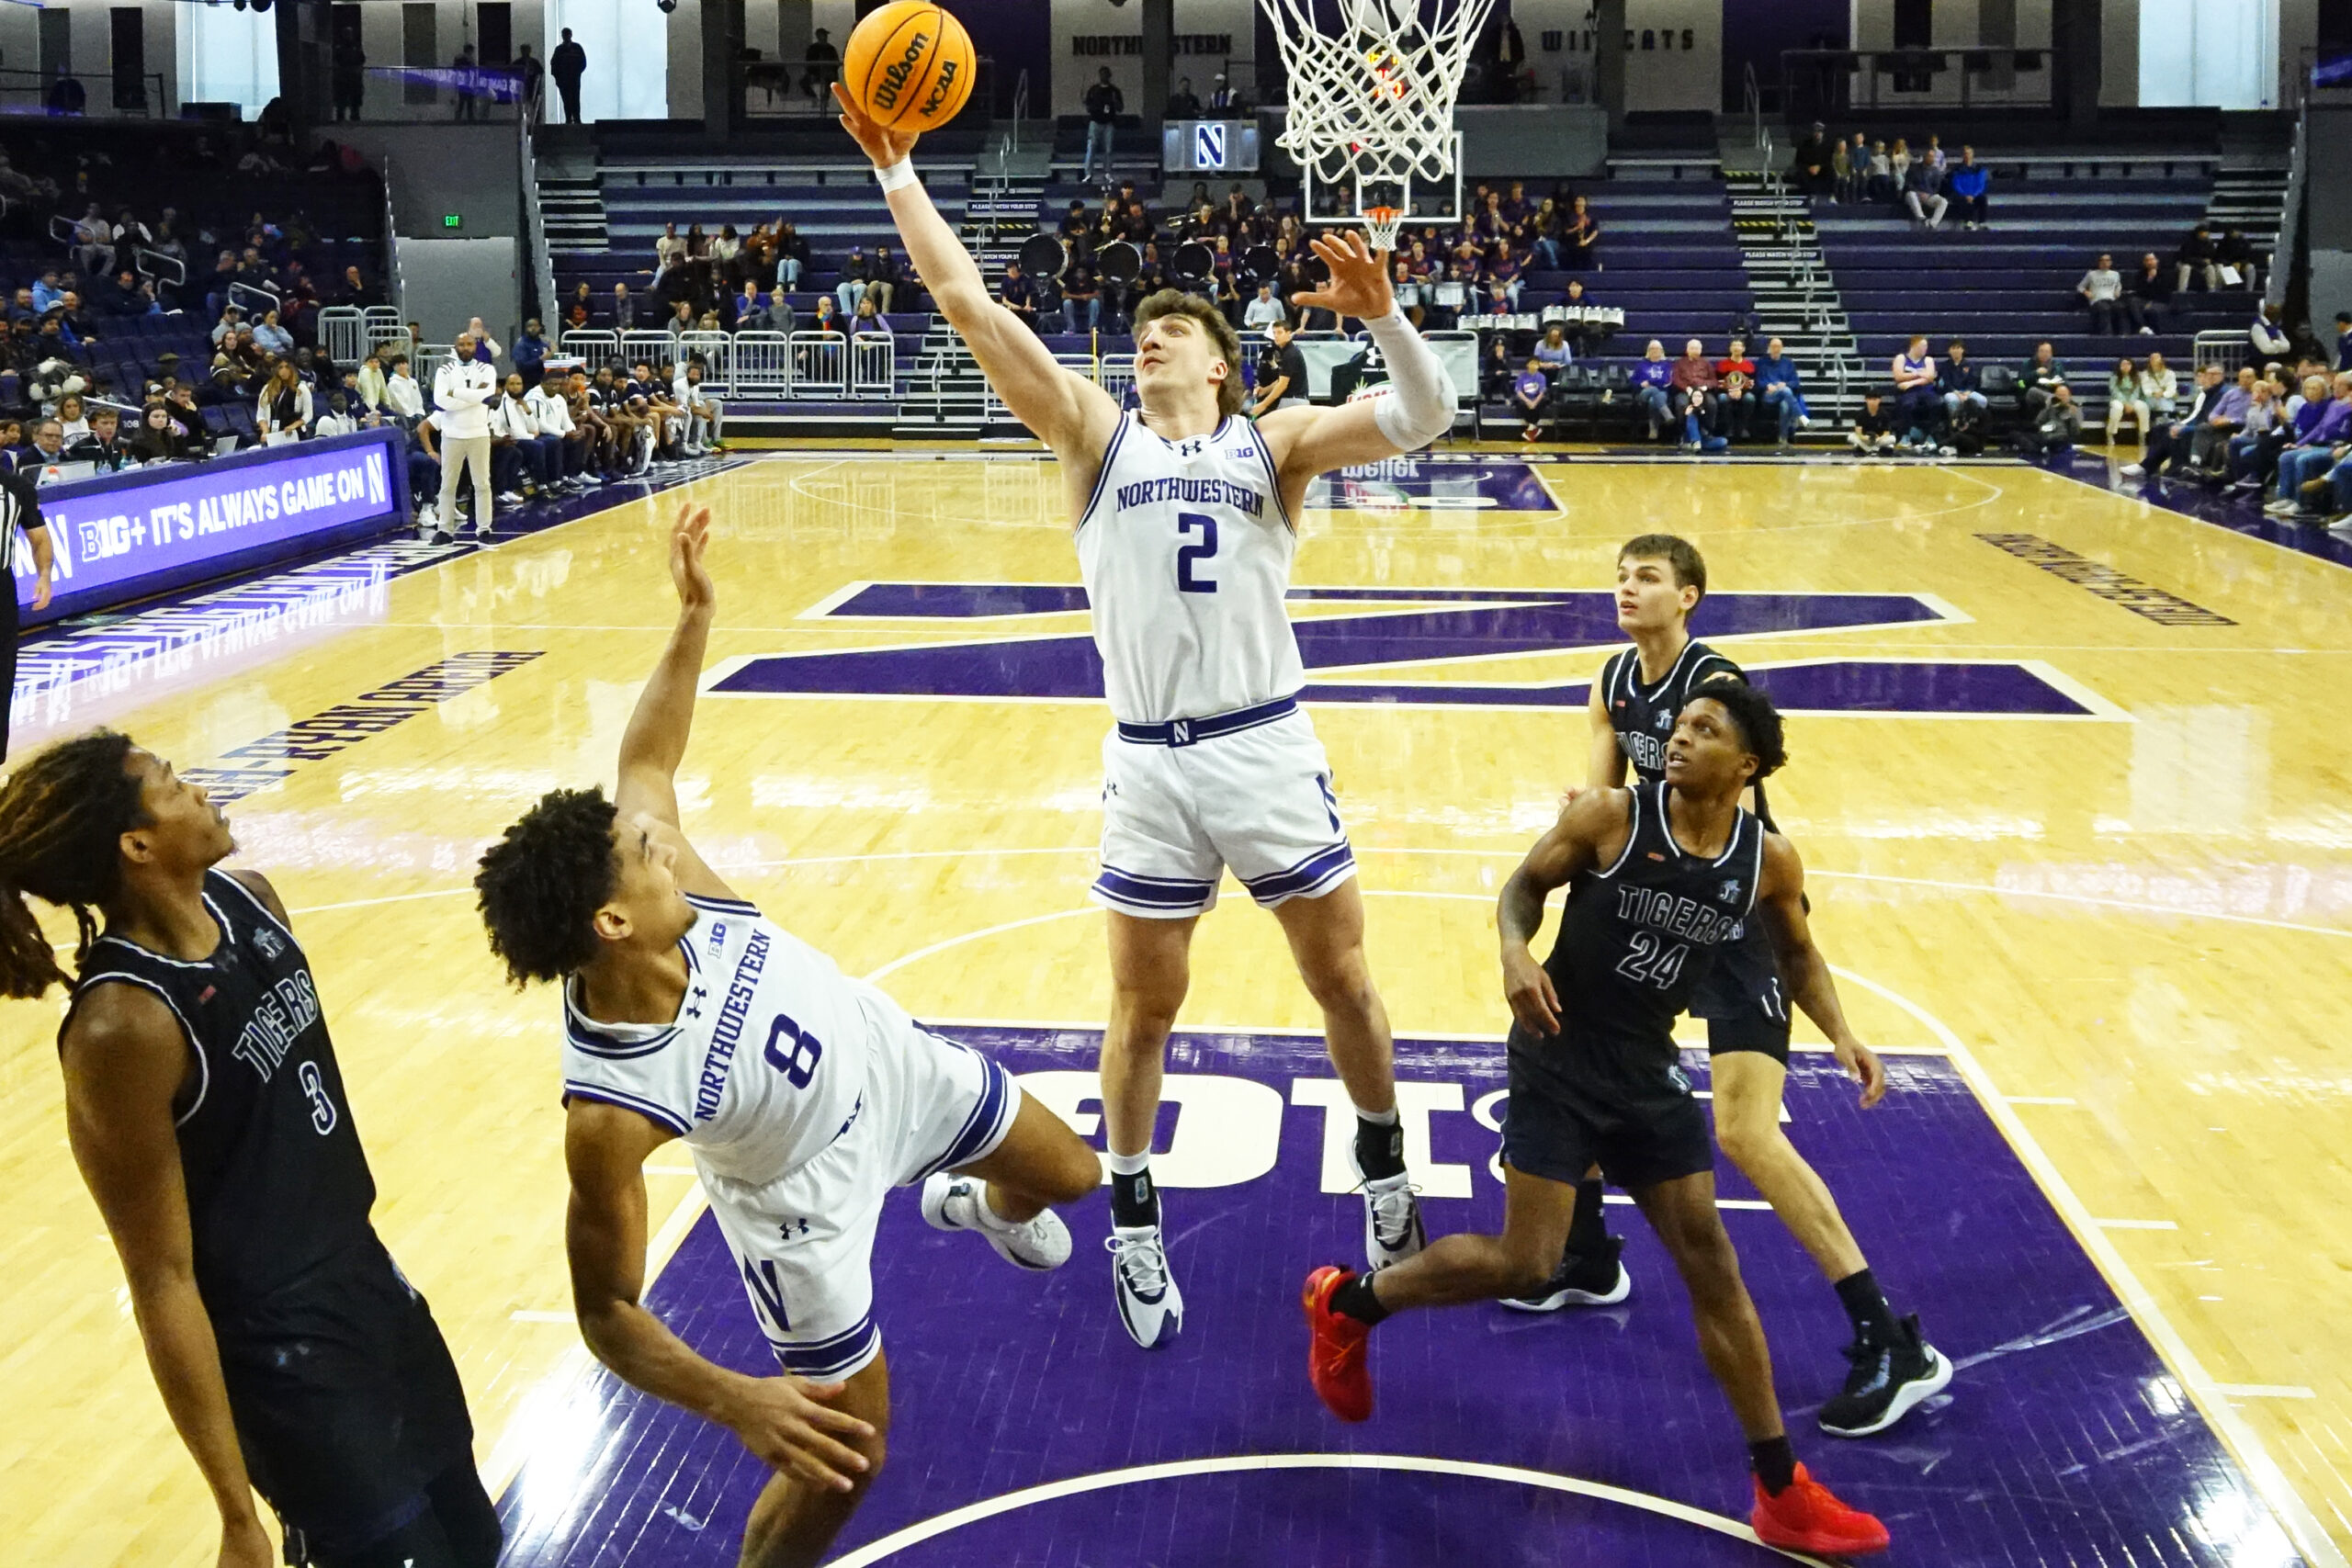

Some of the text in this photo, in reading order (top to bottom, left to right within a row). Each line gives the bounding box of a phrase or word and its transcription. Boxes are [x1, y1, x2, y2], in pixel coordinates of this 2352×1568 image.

[874, 32, 929, 109] Wilson
[920, 60, 957, 117] NCAA
[1197, 124, 1225, 167] N
[445, 215, 459, 227] EXIT
[151, 502, 195, 547] IT'S
[198, 485, 279, 536] ALWAYS
[281, 472, 336, 516] GAME
[337, 467, 365, 503] ON
[1117, 477, 1265, 520] NORTHWESTERN
[1177, 512, 1218, 593] 2
[1173, 720, 1190, 743] N
[1617, 884, 1734, 945] TIGERS
[1615, 930, 1690, 990] 24
[231, 968, 319, 1084] TIGERS
[694, 929, 771, 1122] NORTHWESTERN
[763, 1012, 823, 1090] 8
[299, 1060, 337, 1136] 3
